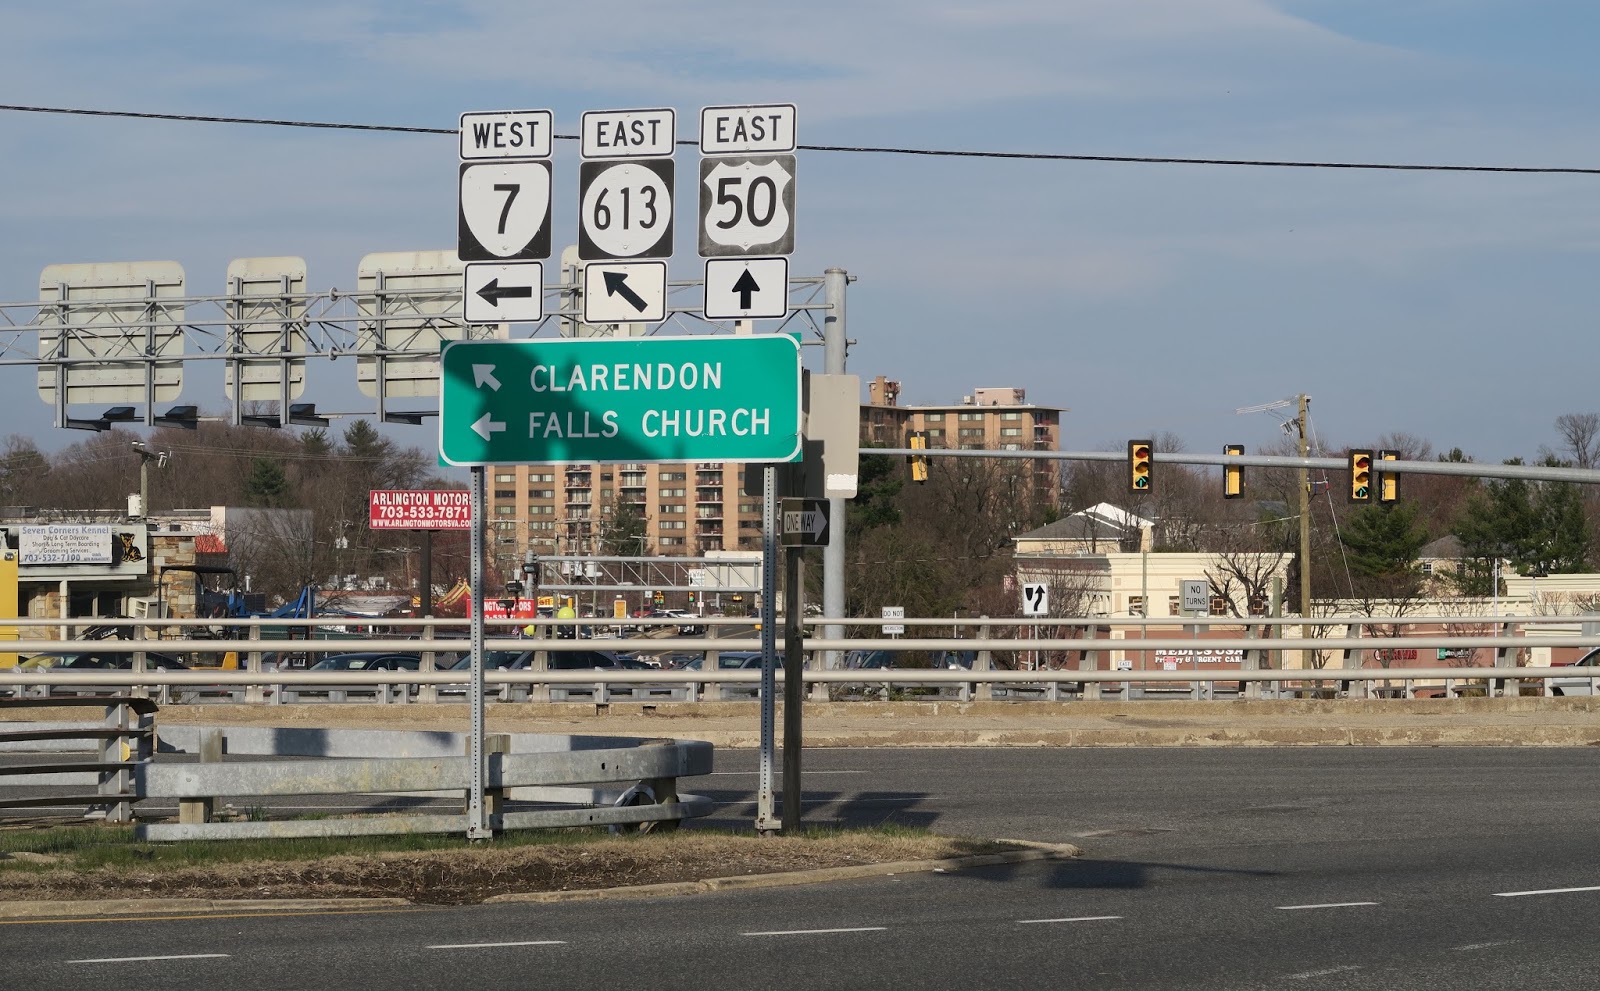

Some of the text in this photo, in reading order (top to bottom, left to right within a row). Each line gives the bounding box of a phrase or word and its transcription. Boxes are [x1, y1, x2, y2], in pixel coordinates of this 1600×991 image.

[473, 121, 539, 149] WEST
[597, 119, 661, 147] EAST
[716, 115, 782, 143] EAST
[493, 183, 521, 235] 7
[593, 185, 657, 230] 613
[715, 176, 777, 229] 50
[529, 362, 722, 393] CLARENDON
[528, 408, 771, 439] FALLS CHURCH
[372, 492, 471, 506] ARLINGTON MOTOR
[372, 519, 471, 528] WWW.ARLINGTONMOTORSVA.CO
[379, 506, 468, 518] 703-533-7871
[786, 513, 816, 532] ONE WAY
[22, 526, 109, 535] Seven Corners Kennel
[24, 553, 81, 562] 703-532-7100
[1185, 597, 1206, 605] TURNS
[1190, 585, 1201, 594] NO
